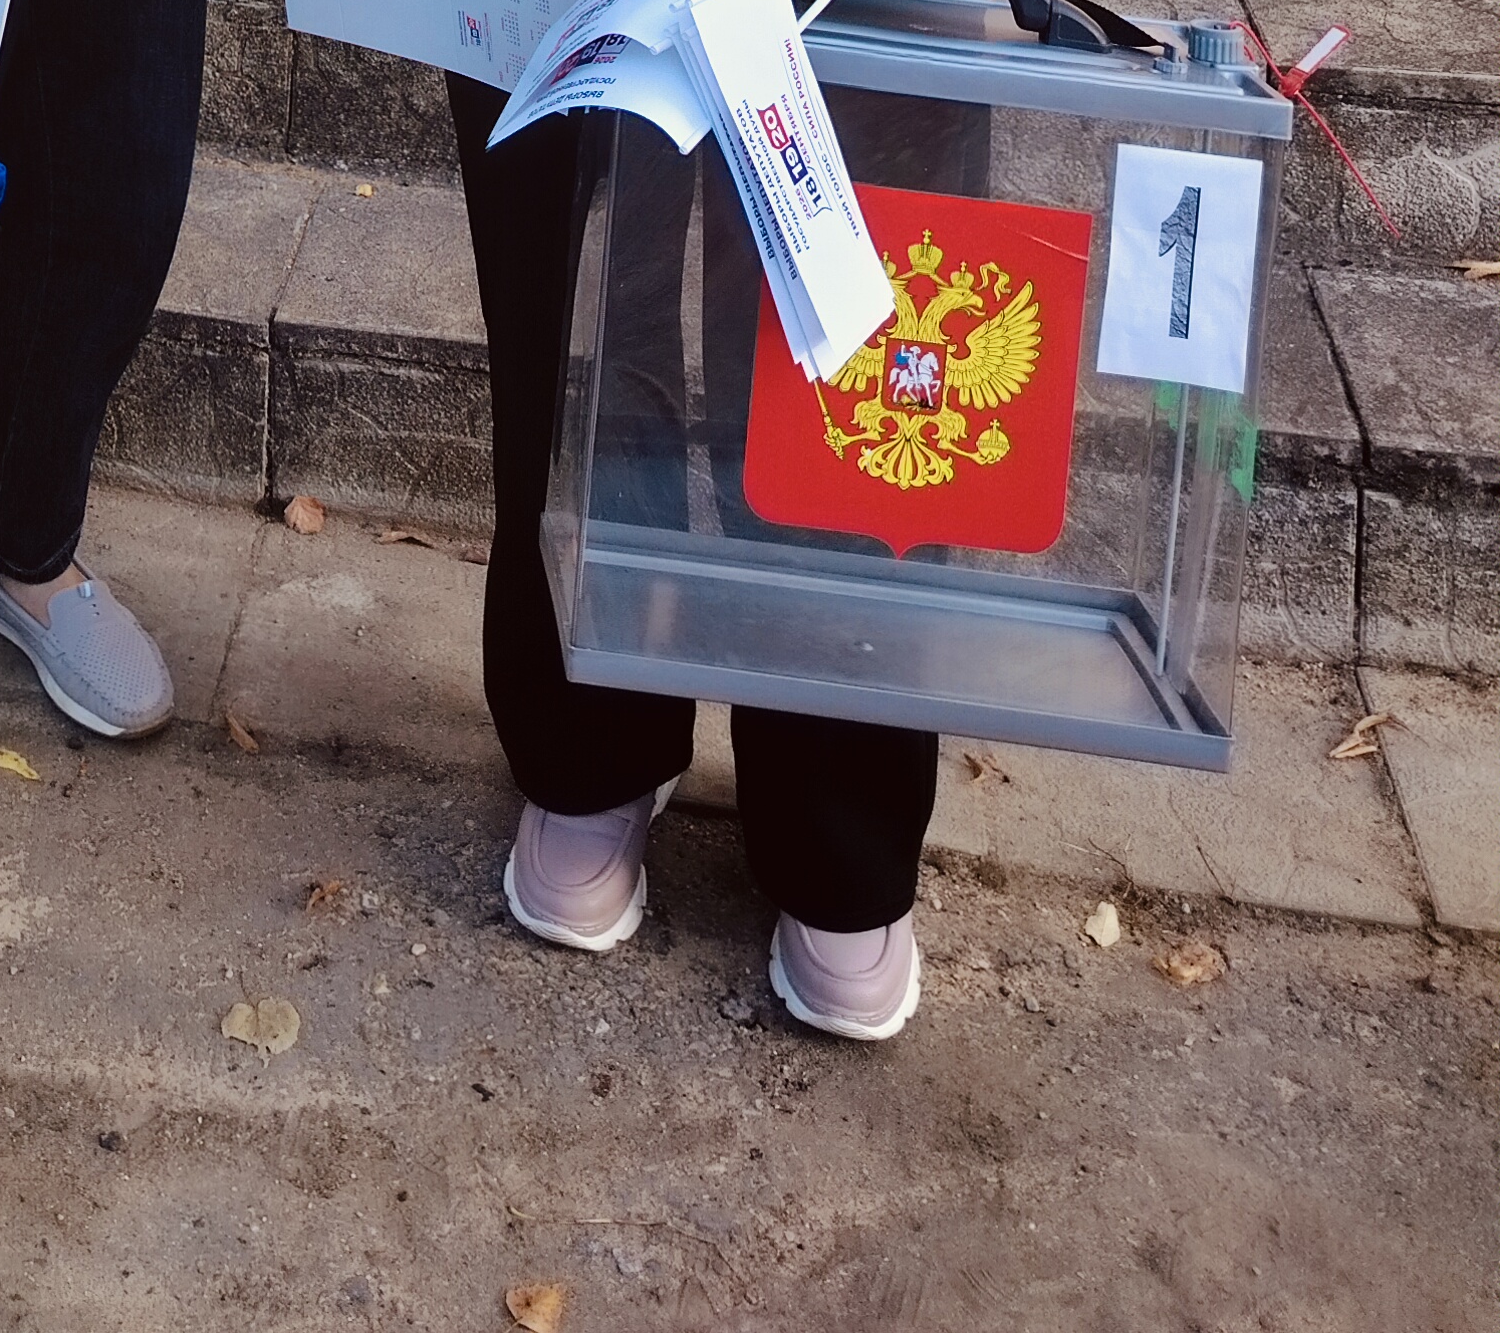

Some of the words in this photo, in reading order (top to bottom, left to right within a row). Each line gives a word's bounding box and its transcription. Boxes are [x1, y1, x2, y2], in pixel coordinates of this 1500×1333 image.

[783, 37, 805, 97] РОССИИ!
[741, 97, 760, 133] ДУМЫ
[761, 107, 786, 145] 20
[780, 92, 812, 163] СЕНТЯБРЯ
[802, 100, 819, 138] СИЛА
[735, 106, 775, 188] ДЕПУТАТОВ
[783, 146, 806, 178] 19
[757, 134, 810, 250] ГОСУДАРСТВЕННОЙ
[803, 175, 825, 207] 18
[821, 152, 843, 198] ГОЛОС
[771, 190, 802, 253] ВЫБОРЫ
[794, 187, 812, 220] 2026
[841, 201, 862, 239] ТВОЙ
[767, 214, 799, 280] ВЫБОРЫ
[1159, 186, 1202, 339] 1
